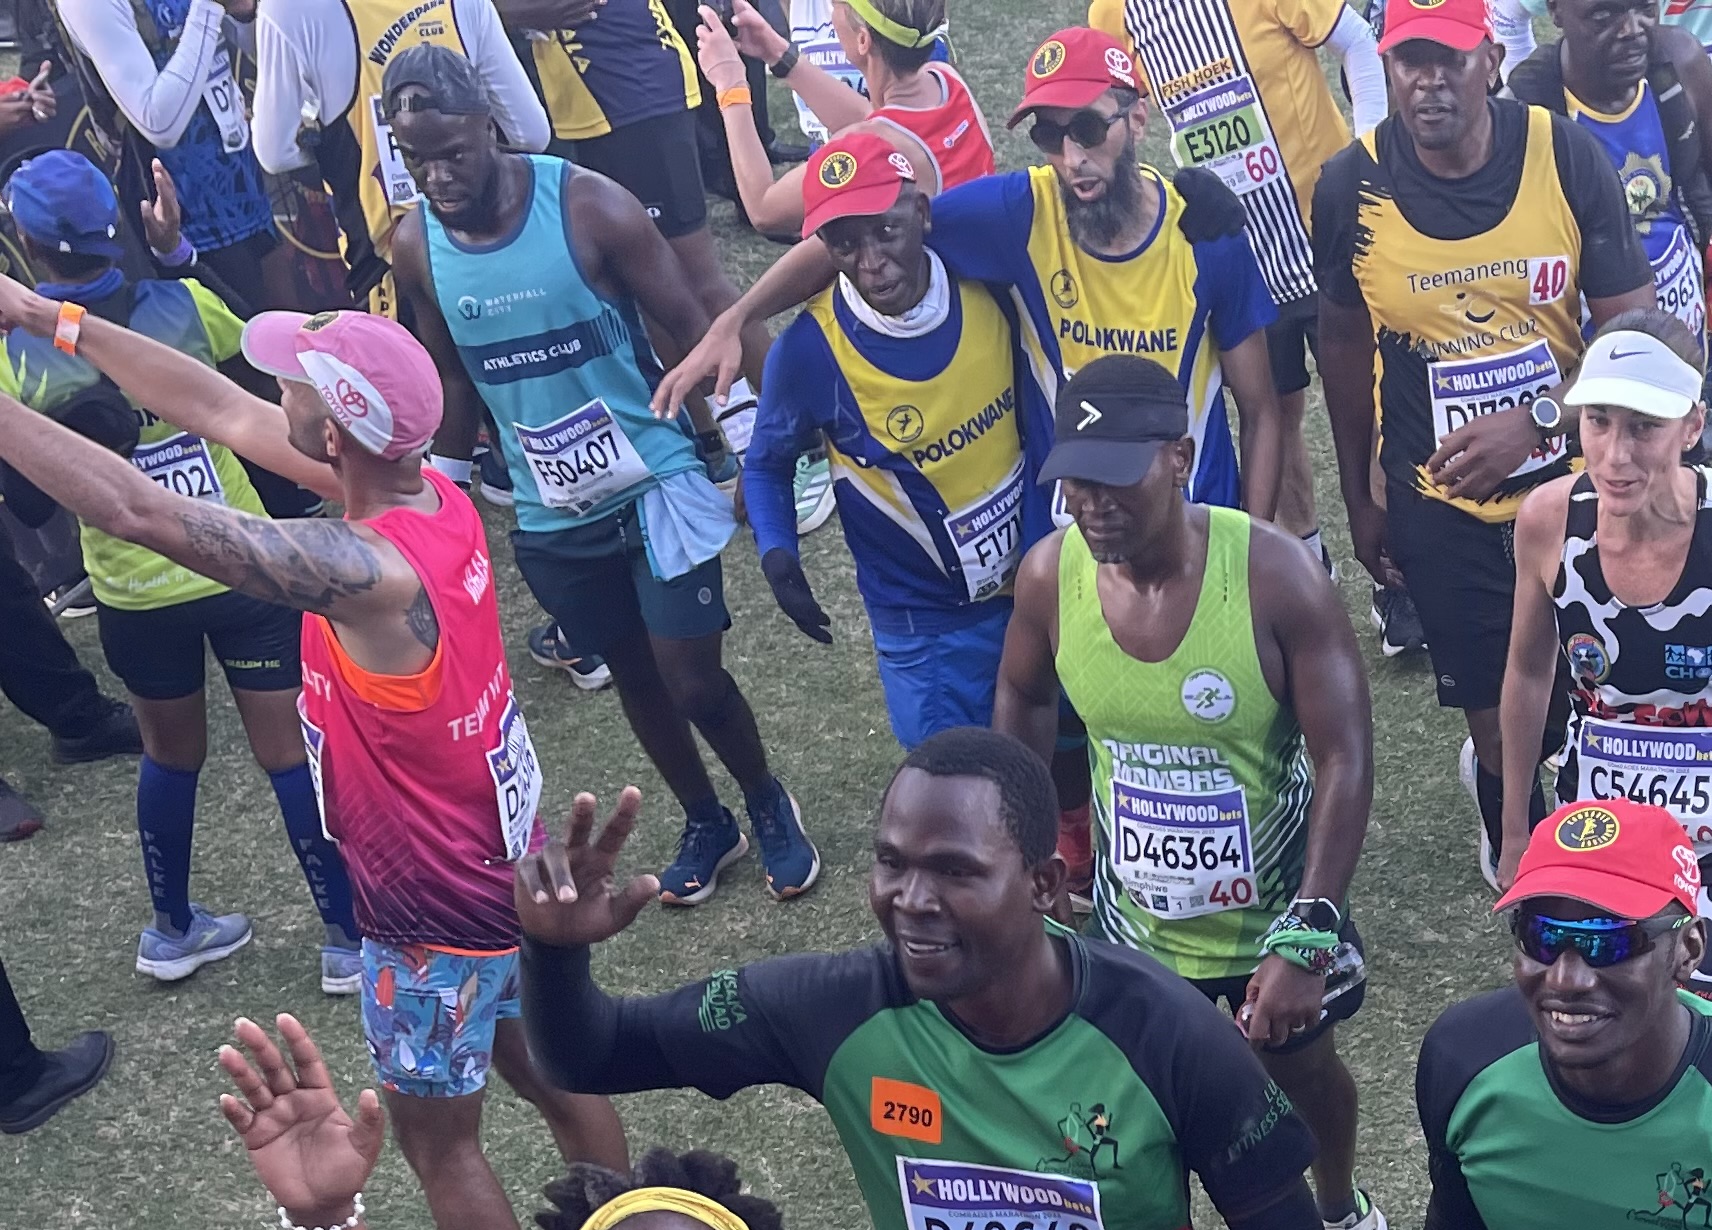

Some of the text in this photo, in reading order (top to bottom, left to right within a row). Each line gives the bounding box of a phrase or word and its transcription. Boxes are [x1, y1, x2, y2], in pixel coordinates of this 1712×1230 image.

[419, 26, 445, 37] CLUB
[1161, 60, 1232, 98] FISH HOEK
[1184, 114, 1251, 163] E3120
[1245, 145, 1279, 183] 60
[1406, 258, 1529, 295] Teemaneng
[1533, 260, 1567, 301] 40
[485, 287, 548, 307] WATERFALL
[487, 305, 513, 317] CITY
[483, 338, 582, 372] ATHLETICS CLUB
[320, 383, 354, 431] TOYOTA
[912, 386, 1016, 468] POLOKWANE
[532, 429, 621, 487] F50407
[447, 699, 491, 742] TEAM
[1590, 765, 1711, 815] C54645
[1123, 826, 1241, 871] D46364
[1209, 877, 1253, 907] 40
[883, 1101, 933, 1128] 2790
[948, 1210, 994, 1220] COMRADES
[995, 1210, 1042, 1221] MARATHON
